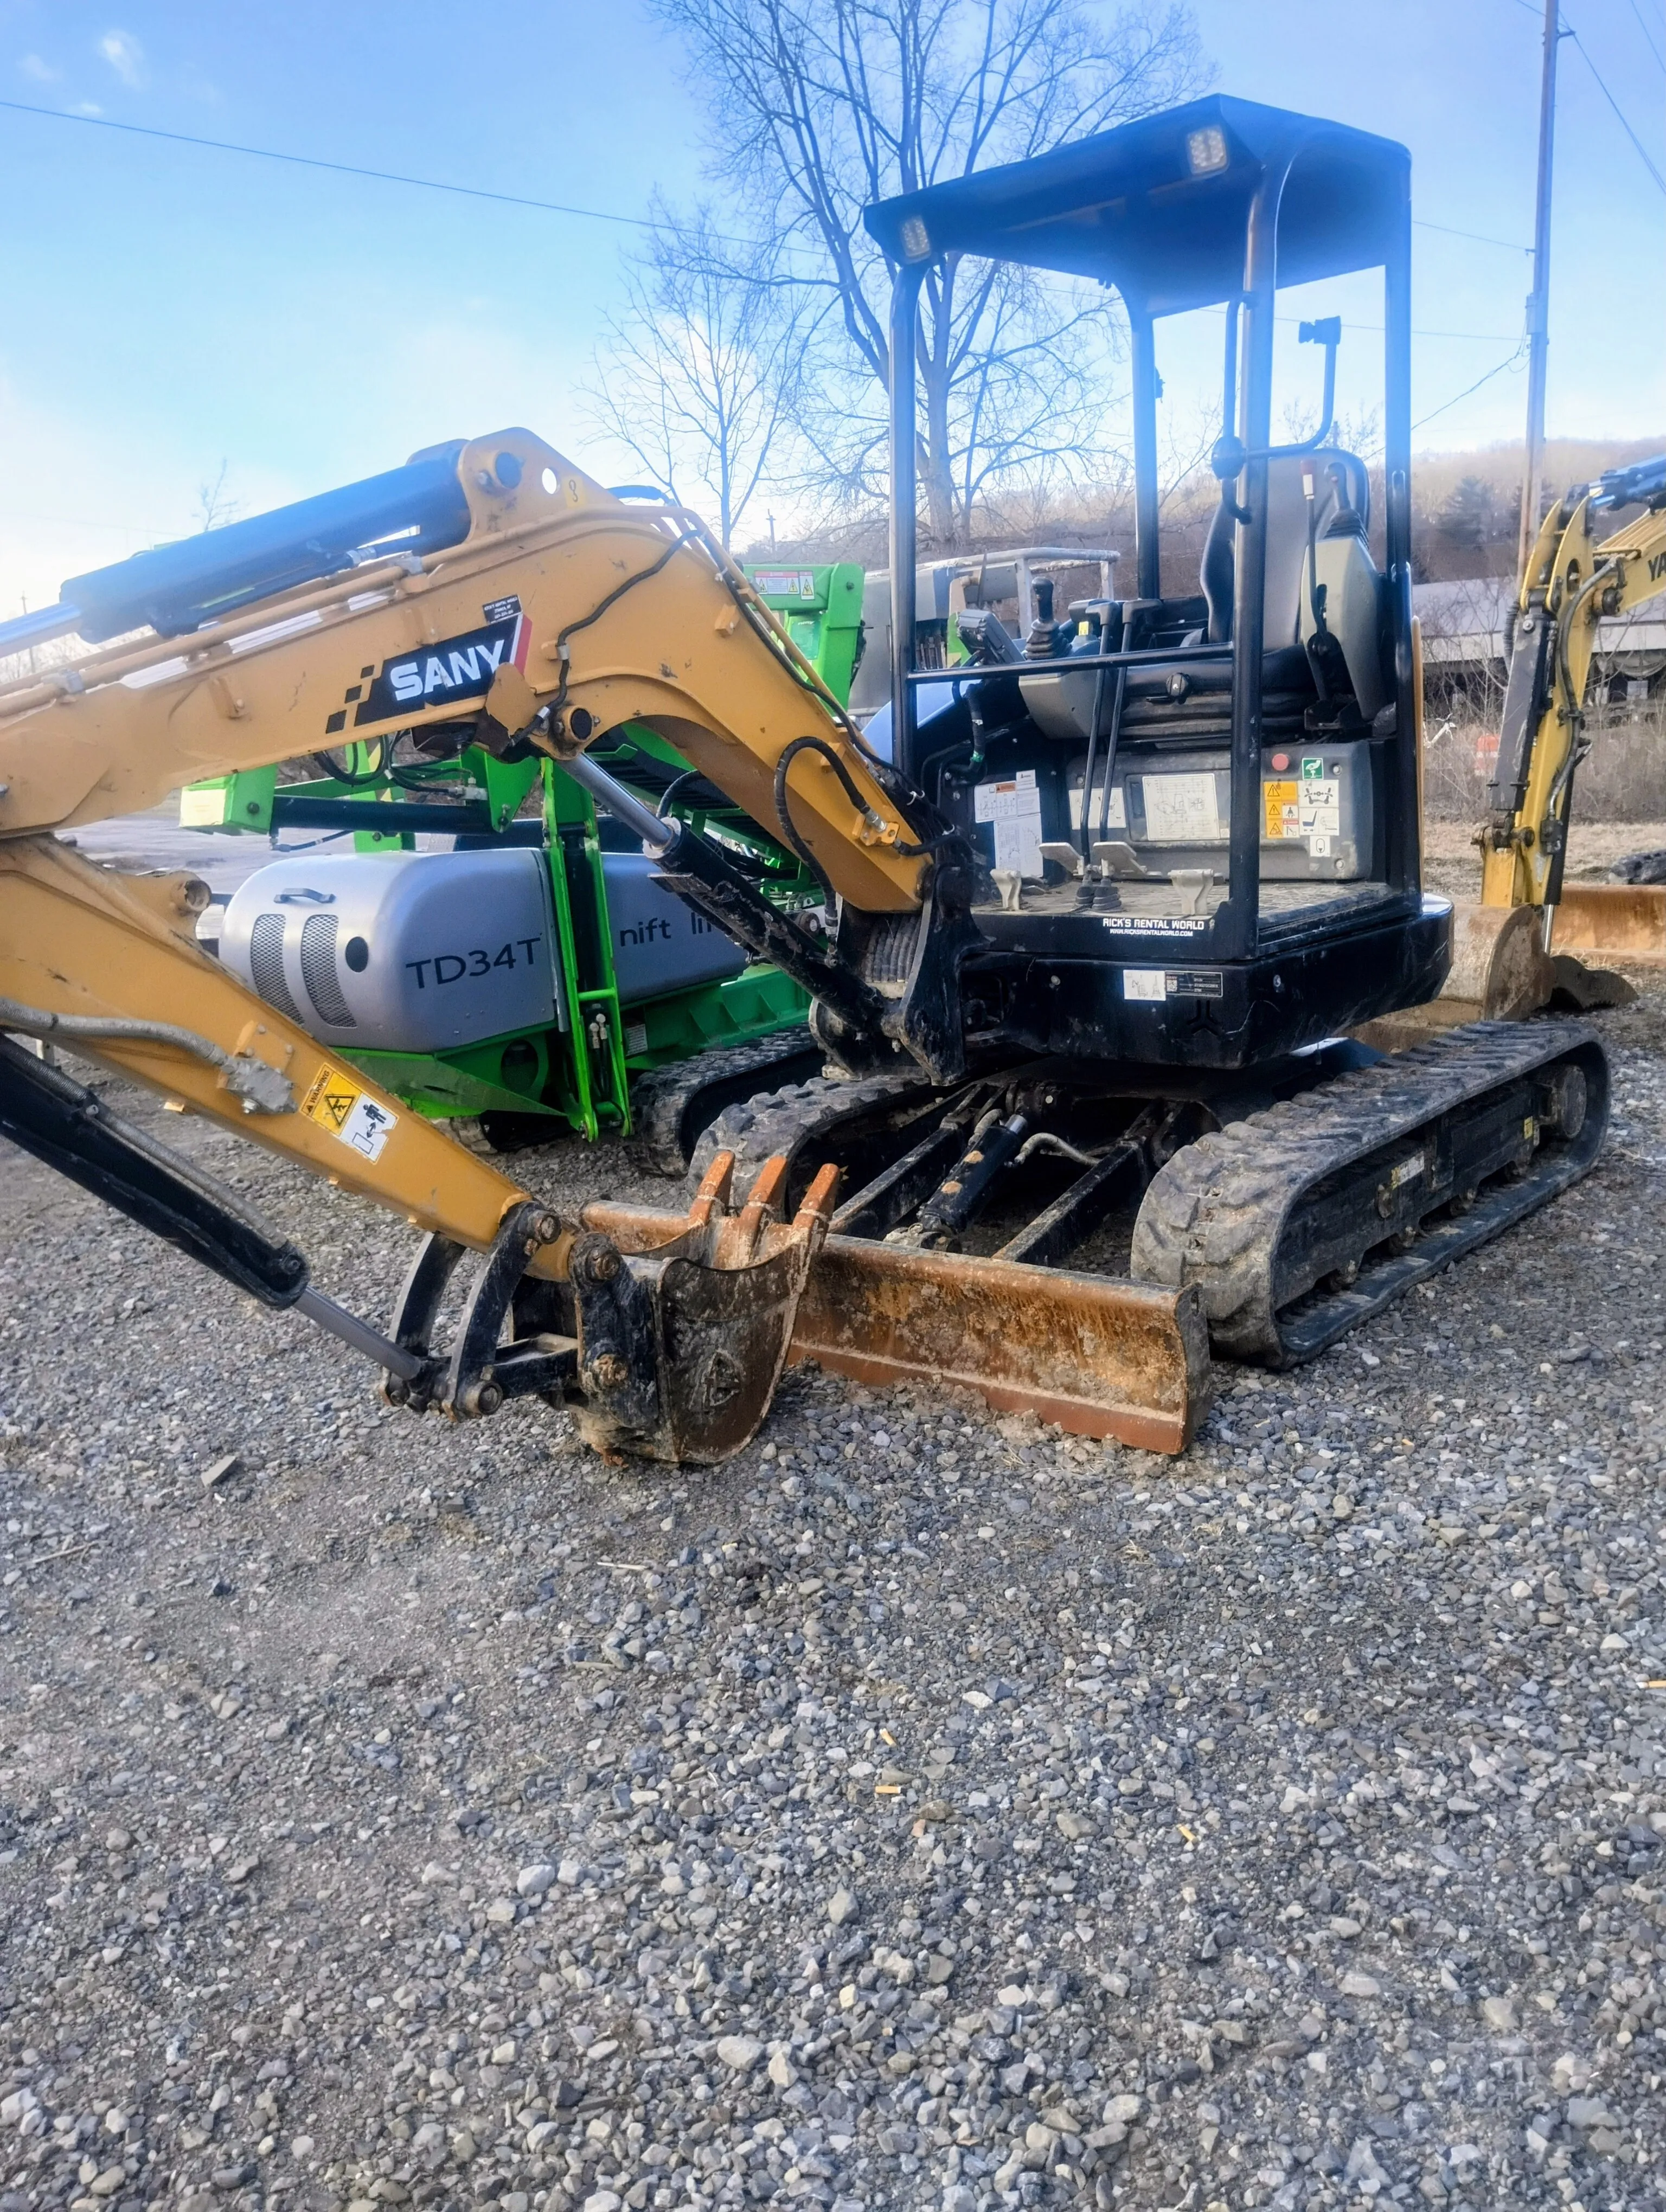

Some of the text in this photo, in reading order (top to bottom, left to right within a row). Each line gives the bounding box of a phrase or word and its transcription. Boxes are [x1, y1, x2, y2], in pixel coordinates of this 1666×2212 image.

[390, 639, 504, 700] SANY
[1103, 918, 1204, 930] RICK'S RENTAL WORLD
[1110, 928, 1194, 937] WWW.RICKSRENTALWORLD.COM
[406, 937, 541, 989] TD34T
[310, 1070, 330, 1104] WARNING
